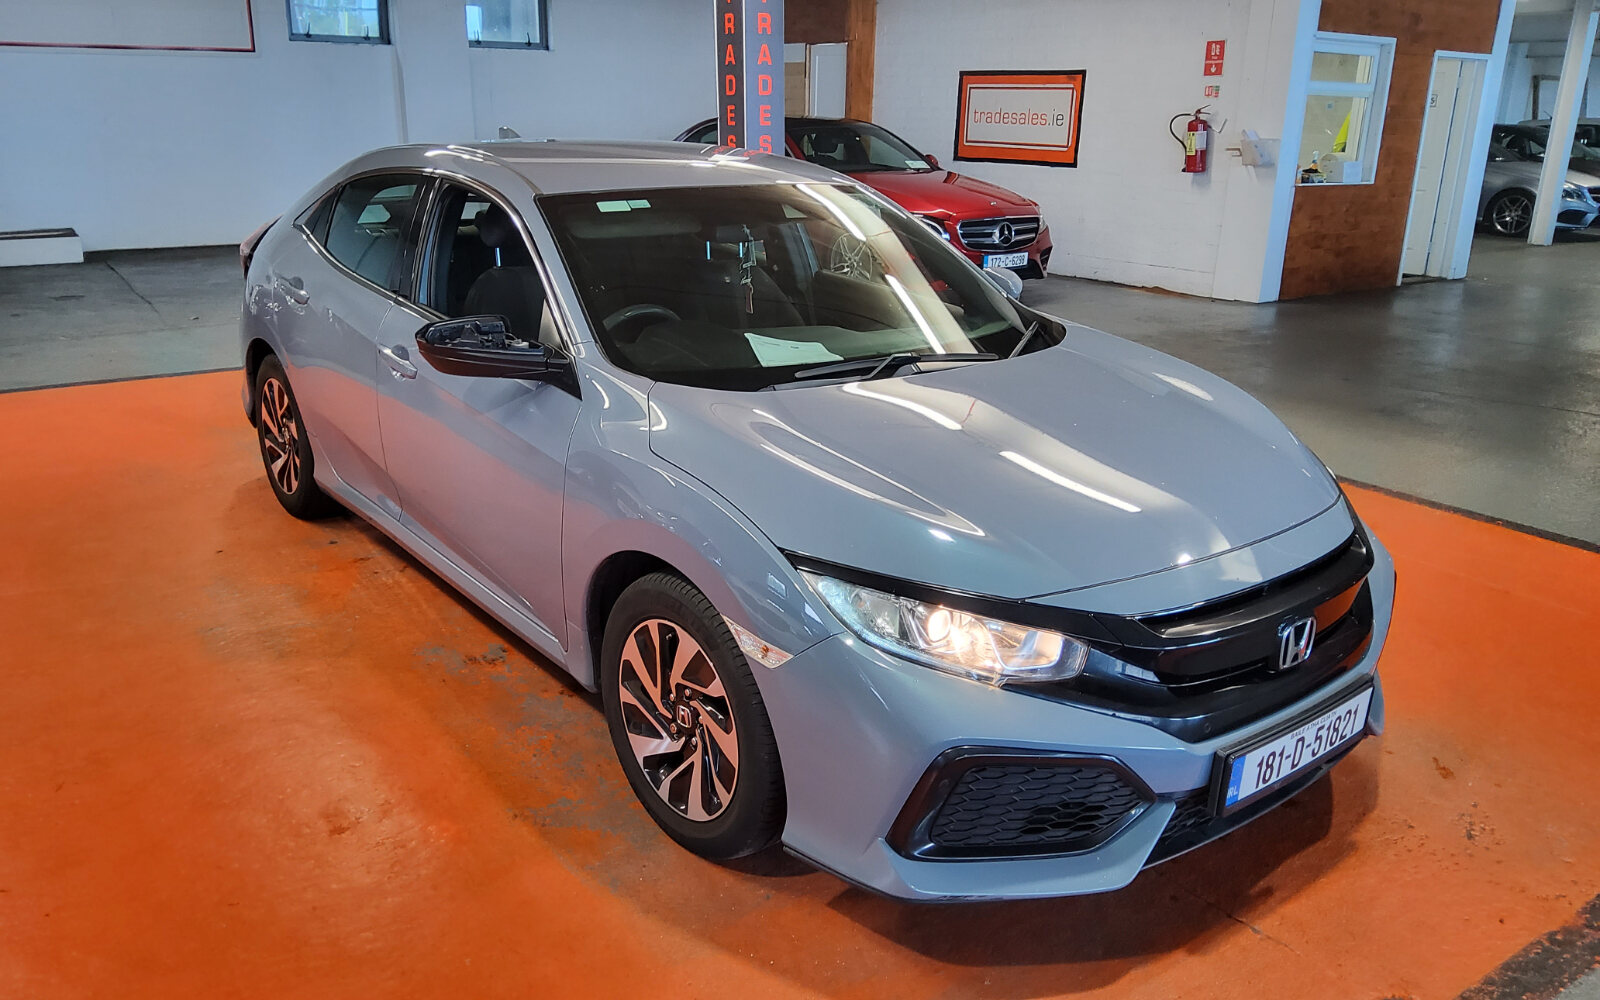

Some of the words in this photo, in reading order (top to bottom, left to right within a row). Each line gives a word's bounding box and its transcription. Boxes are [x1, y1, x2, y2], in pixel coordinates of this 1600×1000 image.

[724, 0, 736, 148] RADES
[757, 0, 772, 154] RADES
[973, 108, 1064, 126] tradesales.ie
[1255, 704, 1359, 789] 181-D-51821
